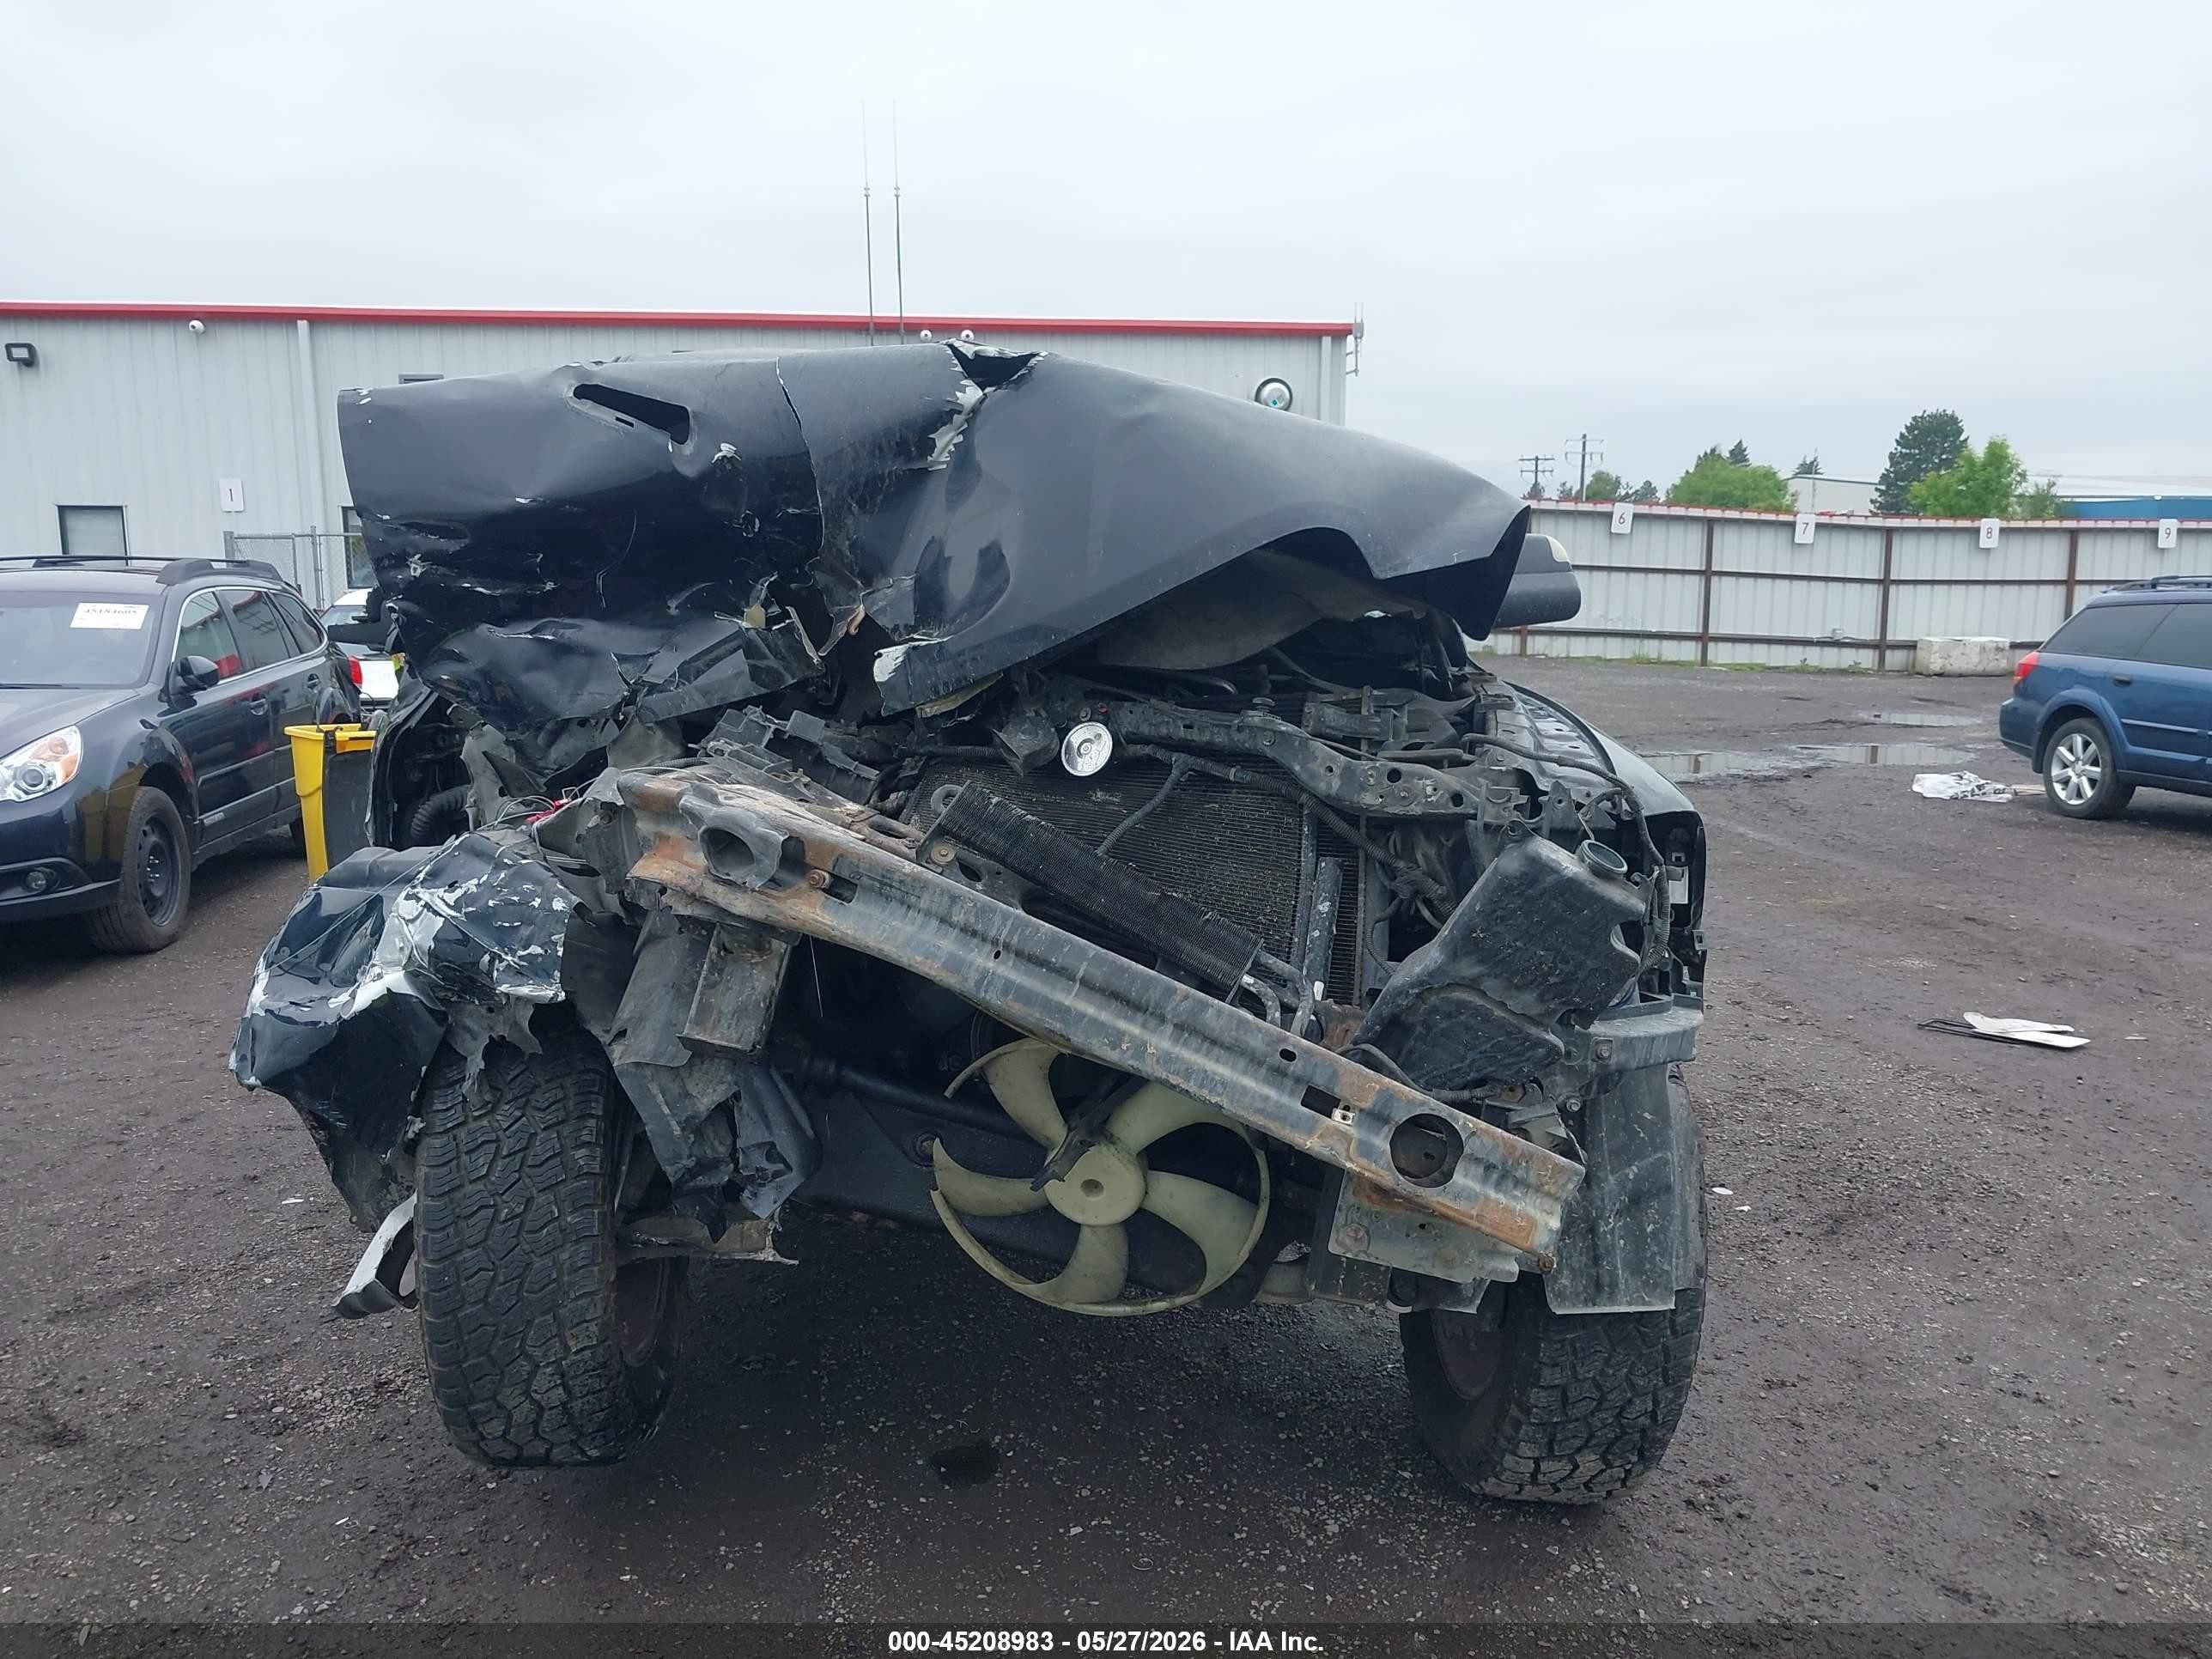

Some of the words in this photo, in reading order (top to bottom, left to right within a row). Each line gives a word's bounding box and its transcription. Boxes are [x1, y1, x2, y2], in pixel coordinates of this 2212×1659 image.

[228, 488, 234, 502] 1
[1618, 513, 1626, 525] 6
[1802, 522, 1809, 535] 7
[1986, 526, 1993, 539] 8
[2165, 527, 2172, 539] 9
